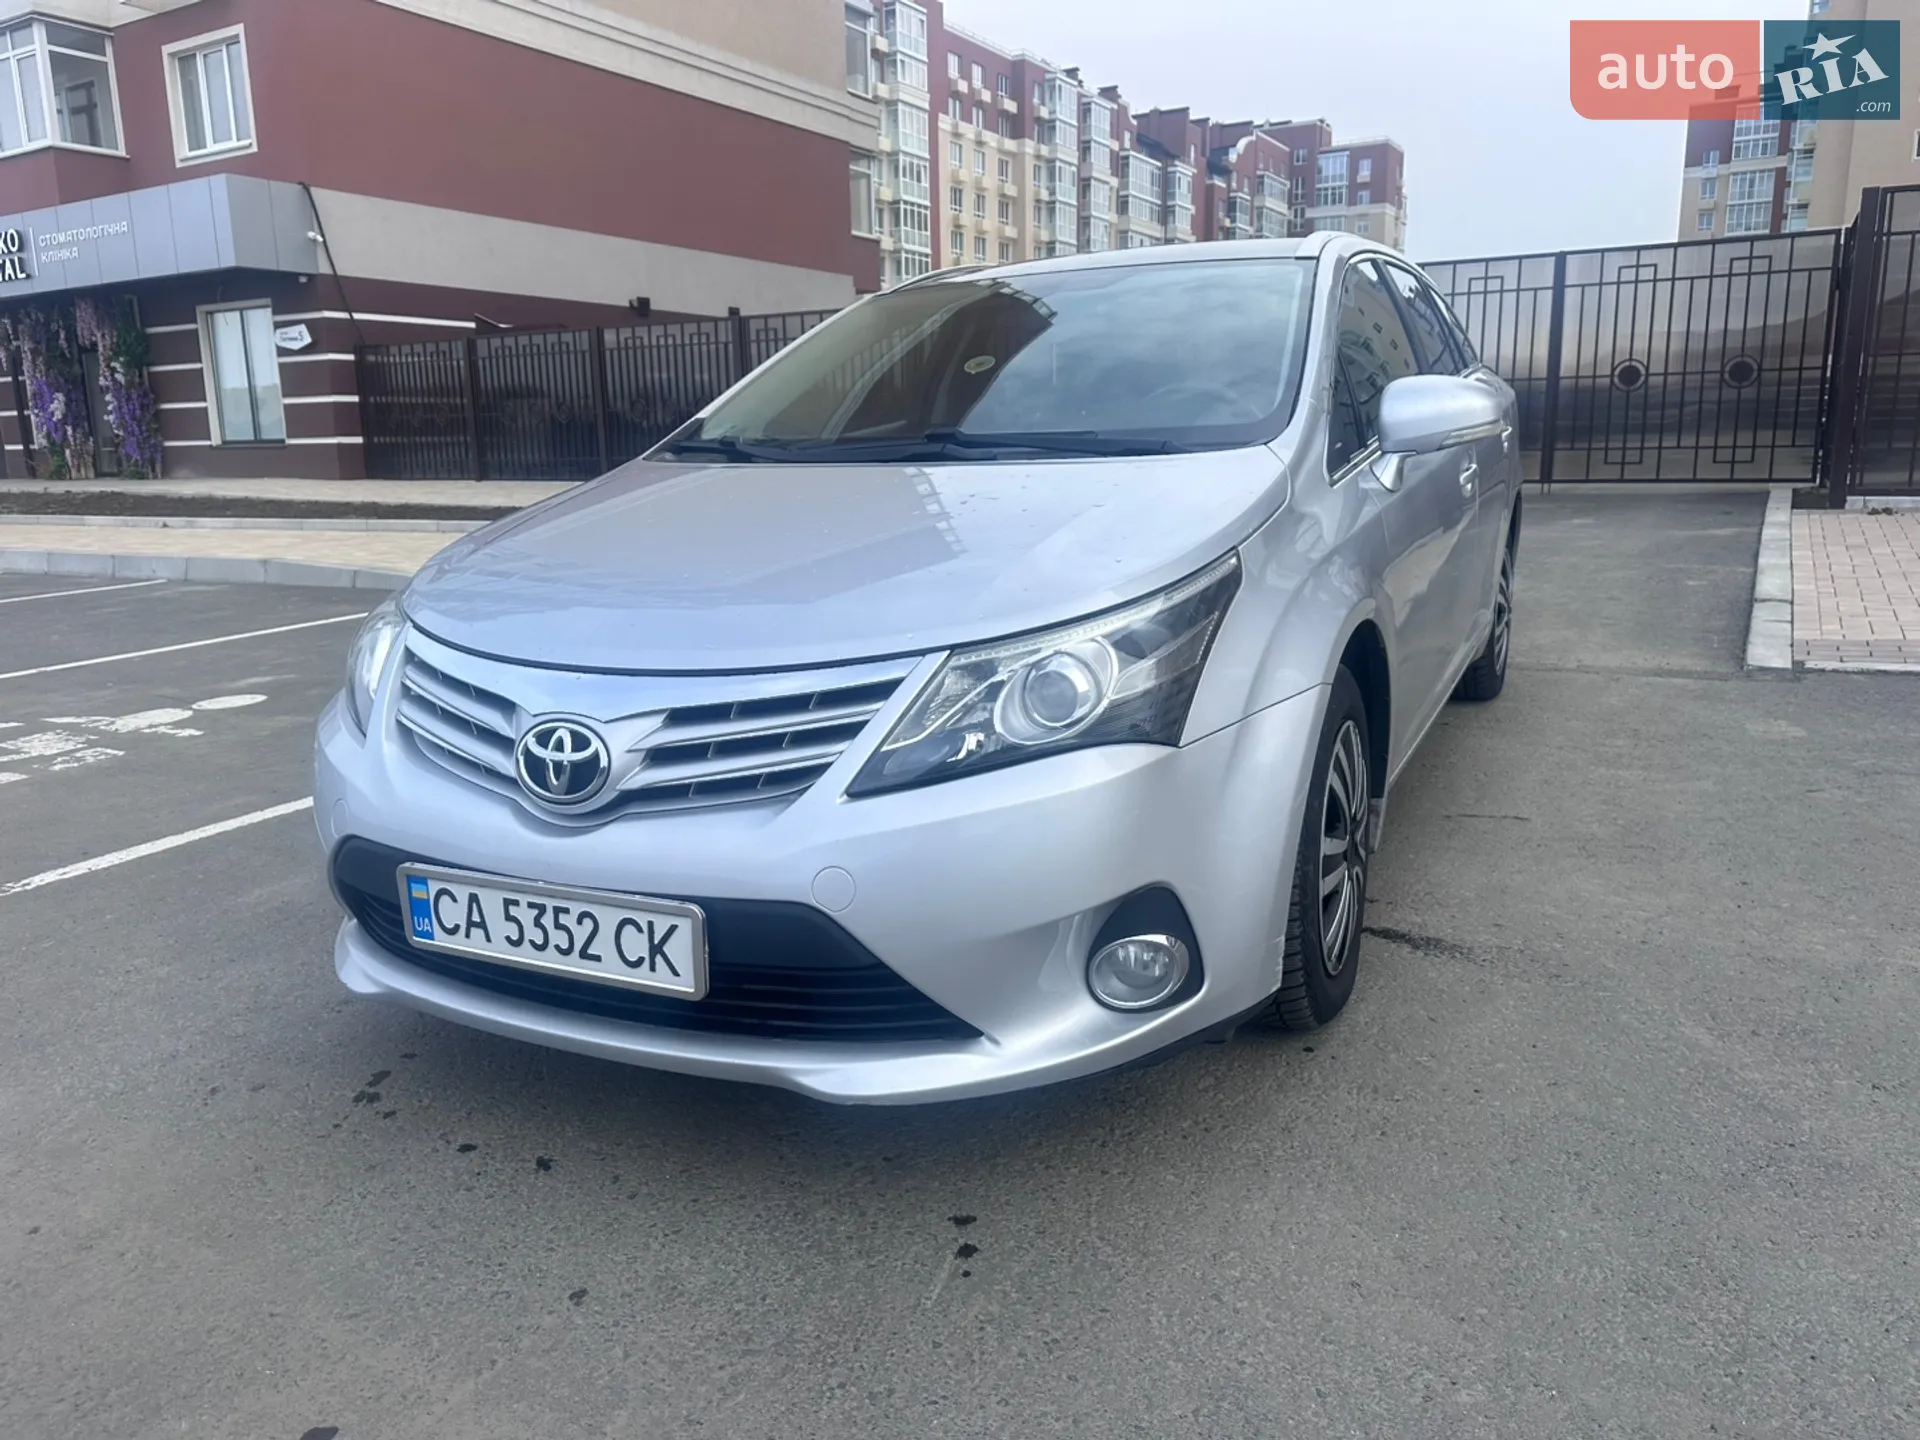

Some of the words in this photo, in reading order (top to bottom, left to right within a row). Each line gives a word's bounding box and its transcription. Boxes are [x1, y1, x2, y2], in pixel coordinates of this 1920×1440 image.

[38, 221, 128, 247] СТОМАТОЛОГІЧНА
[41, 247, 79, 263] КЛІНІКА
[414, 916, 432, 933] UA
[433, 887, 492, 943] CA
[502, 897, 603, 963] 5352
[614, 917, 682, 977] CK
